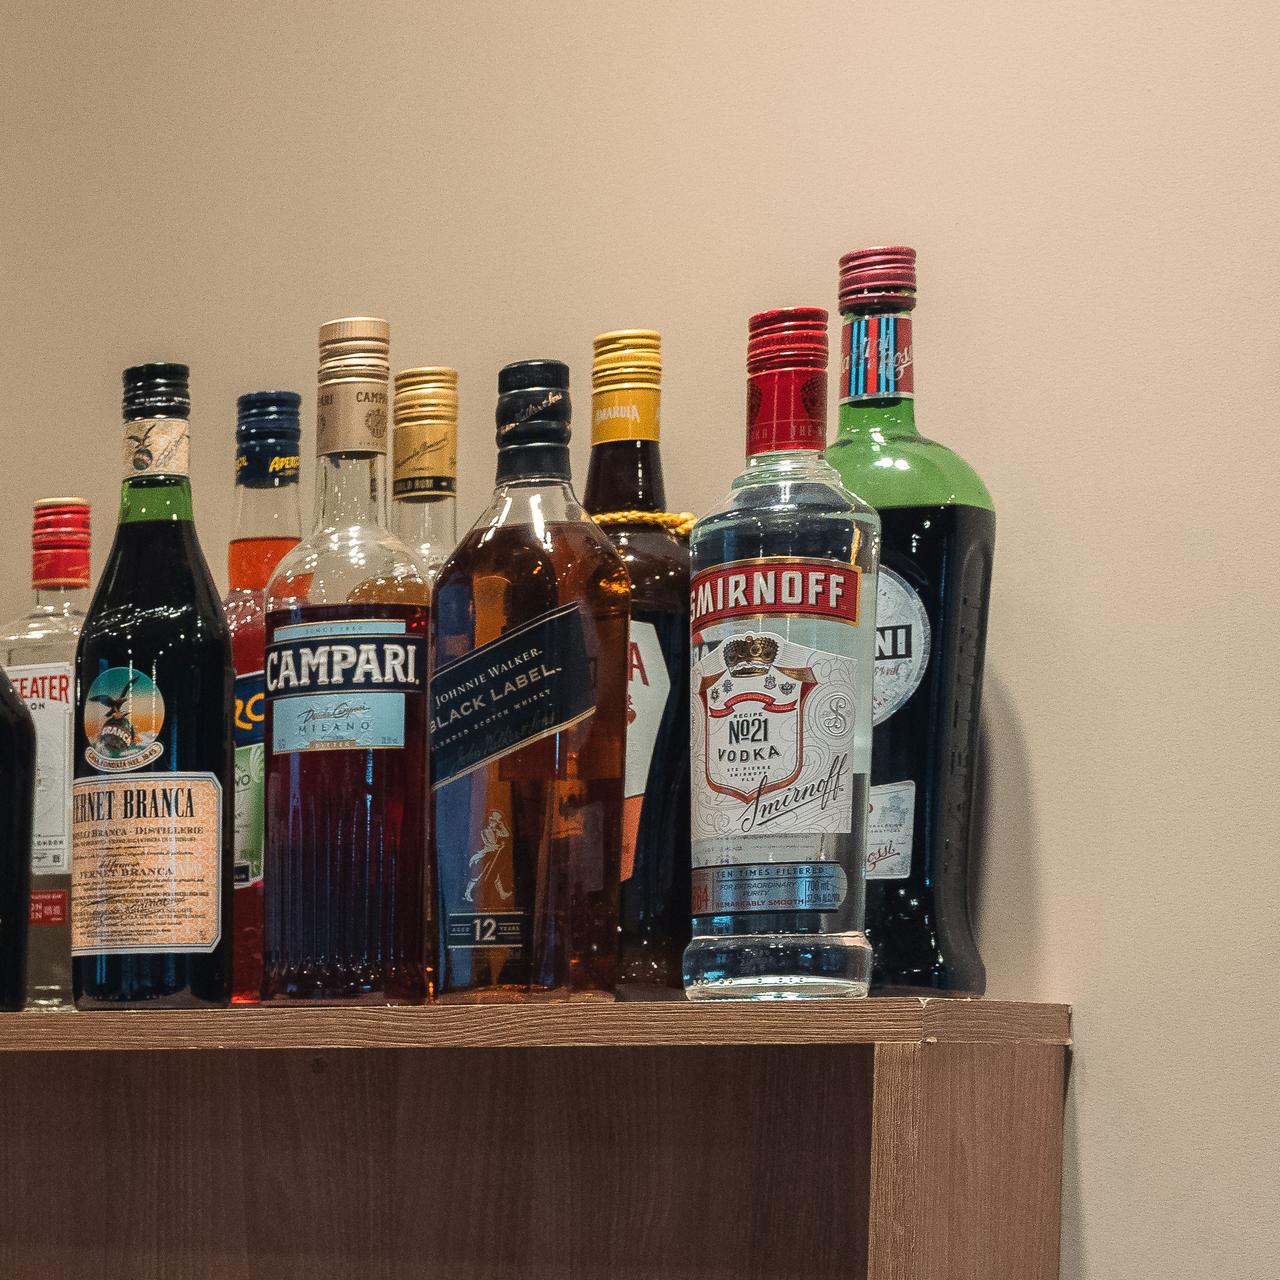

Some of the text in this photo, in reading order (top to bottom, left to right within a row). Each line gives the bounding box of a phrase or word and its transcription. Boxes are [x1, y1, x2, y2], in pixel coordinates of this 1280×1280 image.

[690, 570, 845, 623] SMIRNOFF
[266, 643, 417, 692] CAMPARI
[435, 647, 542, 710] JOHNNIE WALKER
[430, 694, 487, 734] BLACK
[491, 663, 557, 701] LABEL
[299, 721, 371, 734] MILANO
[473, 708, 510, 731] SCOTCH
[717, 745, 781, 762] VODKA
[122, 786, 195, 819] BRANCA
[735, 753, 851, 833] Smirnoff
[740, 869, 771, 877] TIMES
[776, 867, 825, 876] FILTERED
[473, 917, 497, 941] 12
